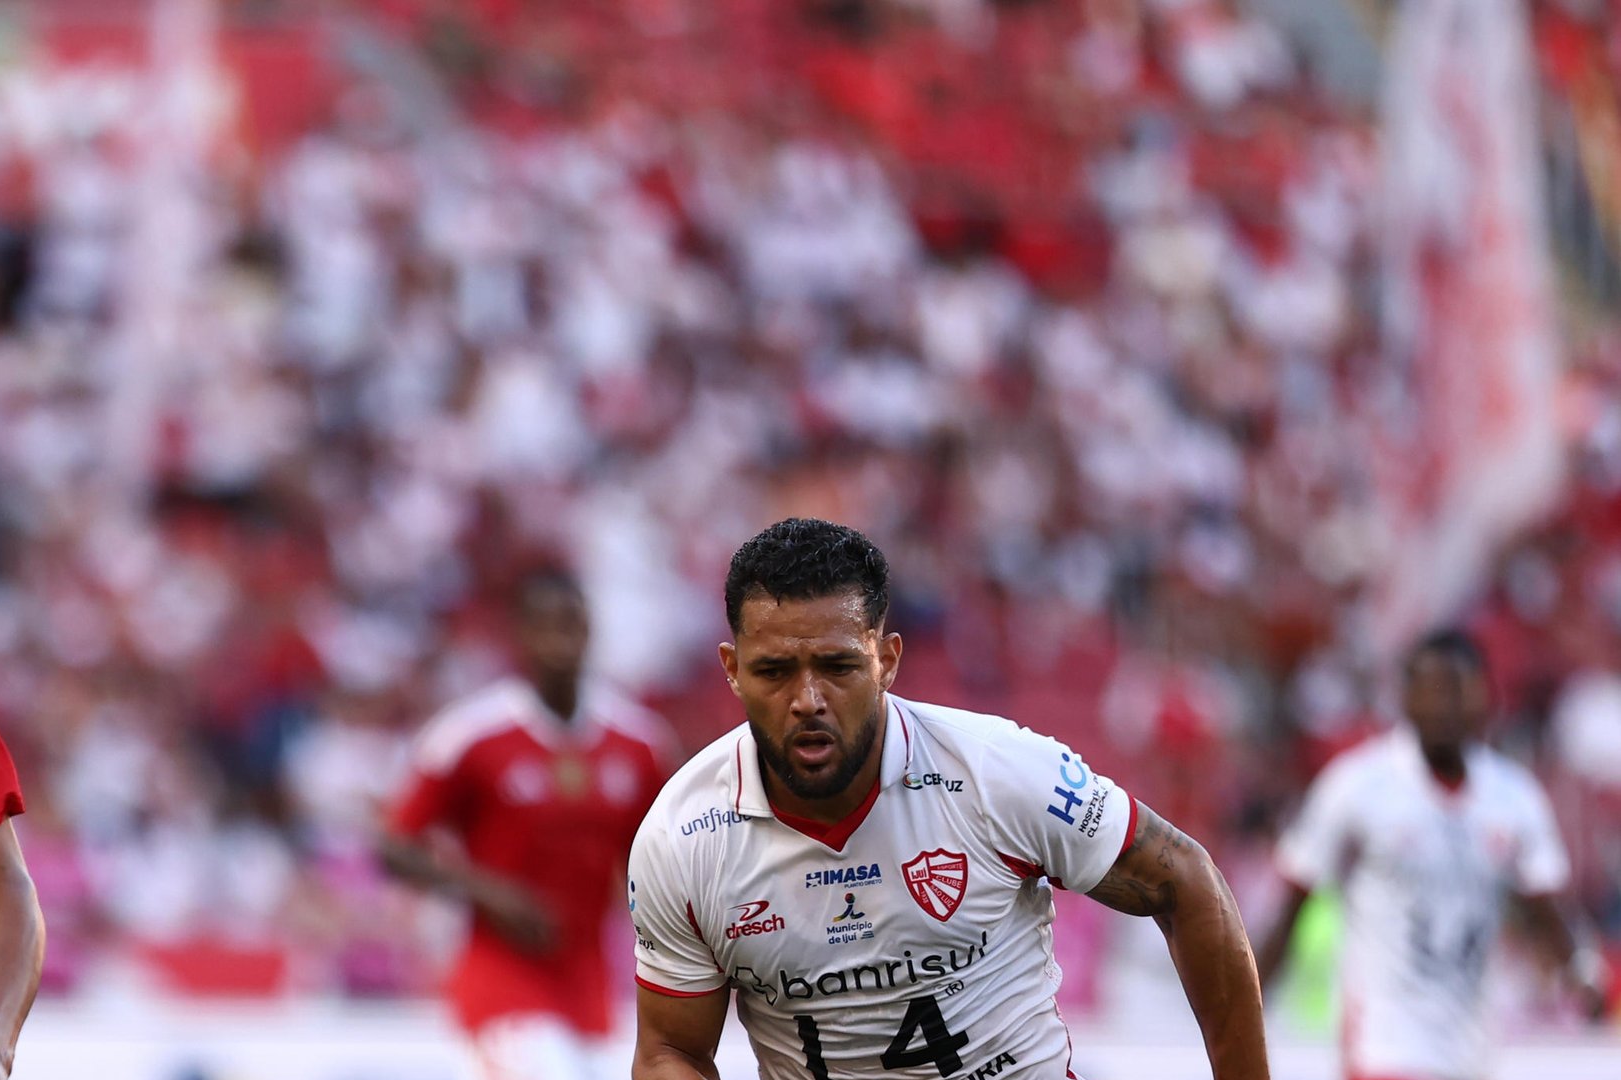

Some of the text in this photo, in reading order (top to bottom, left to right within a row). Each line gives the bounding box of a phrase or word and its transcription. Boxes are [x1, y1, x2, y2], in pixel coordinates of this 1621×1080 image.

[823, 863, 882, 885] IMASA
[935, 875, 963, 889] CLUBE
[725, 914, 786, 940] dresch
[827, 922, 873, 935] Município
[828, 935, 842, 945] de
[780, 931, 987, 999] banrisul
